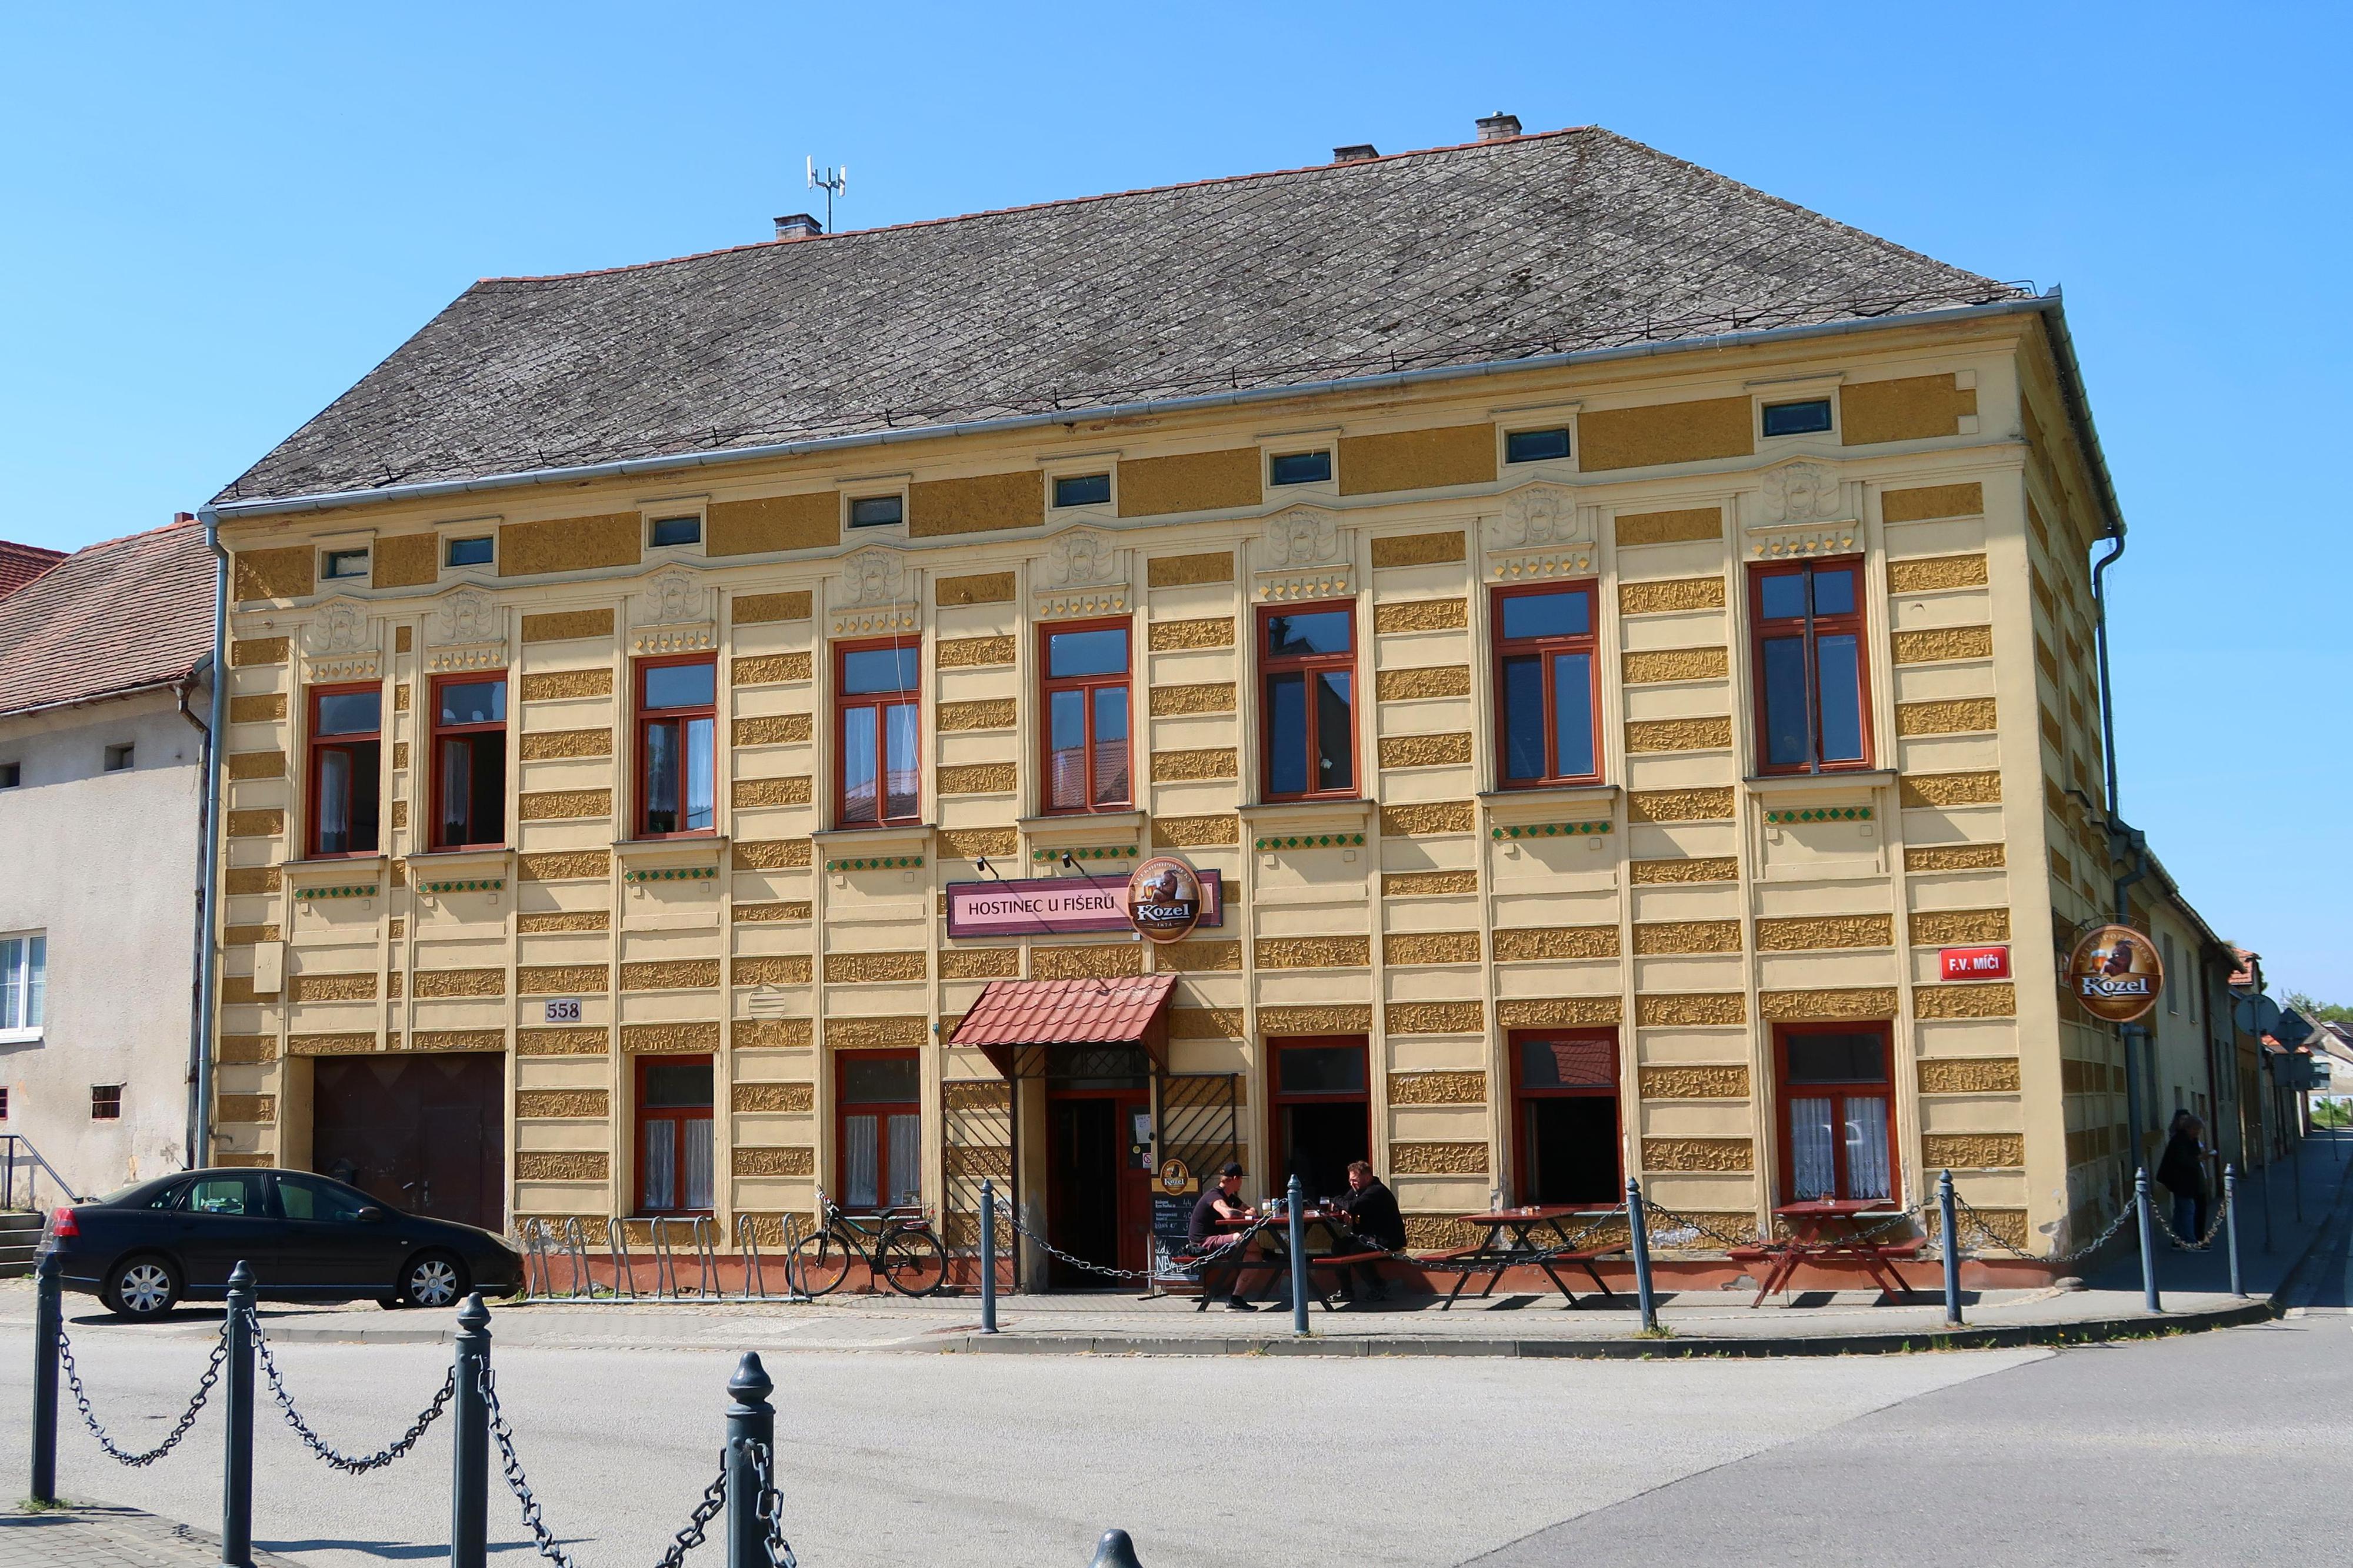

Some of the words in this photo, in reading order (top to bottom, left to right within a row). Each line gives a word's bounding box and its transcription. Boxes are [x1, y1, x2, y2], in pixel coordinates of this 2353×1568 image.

[969, 899, 1044, 915] HOSTINEC
[1048, 899, 1058, 912] U
[1064, 892, 1115, 911] FIŠERŮ
[1136, 903, 1190, 921] Kozel
[1948, 958, 1971, 971] F.V.
[1973, 954, 1999, 970] MÍČI
[2081, 977, 2151, 997] Kozel
[547, 1002, 579, 1019] 558
